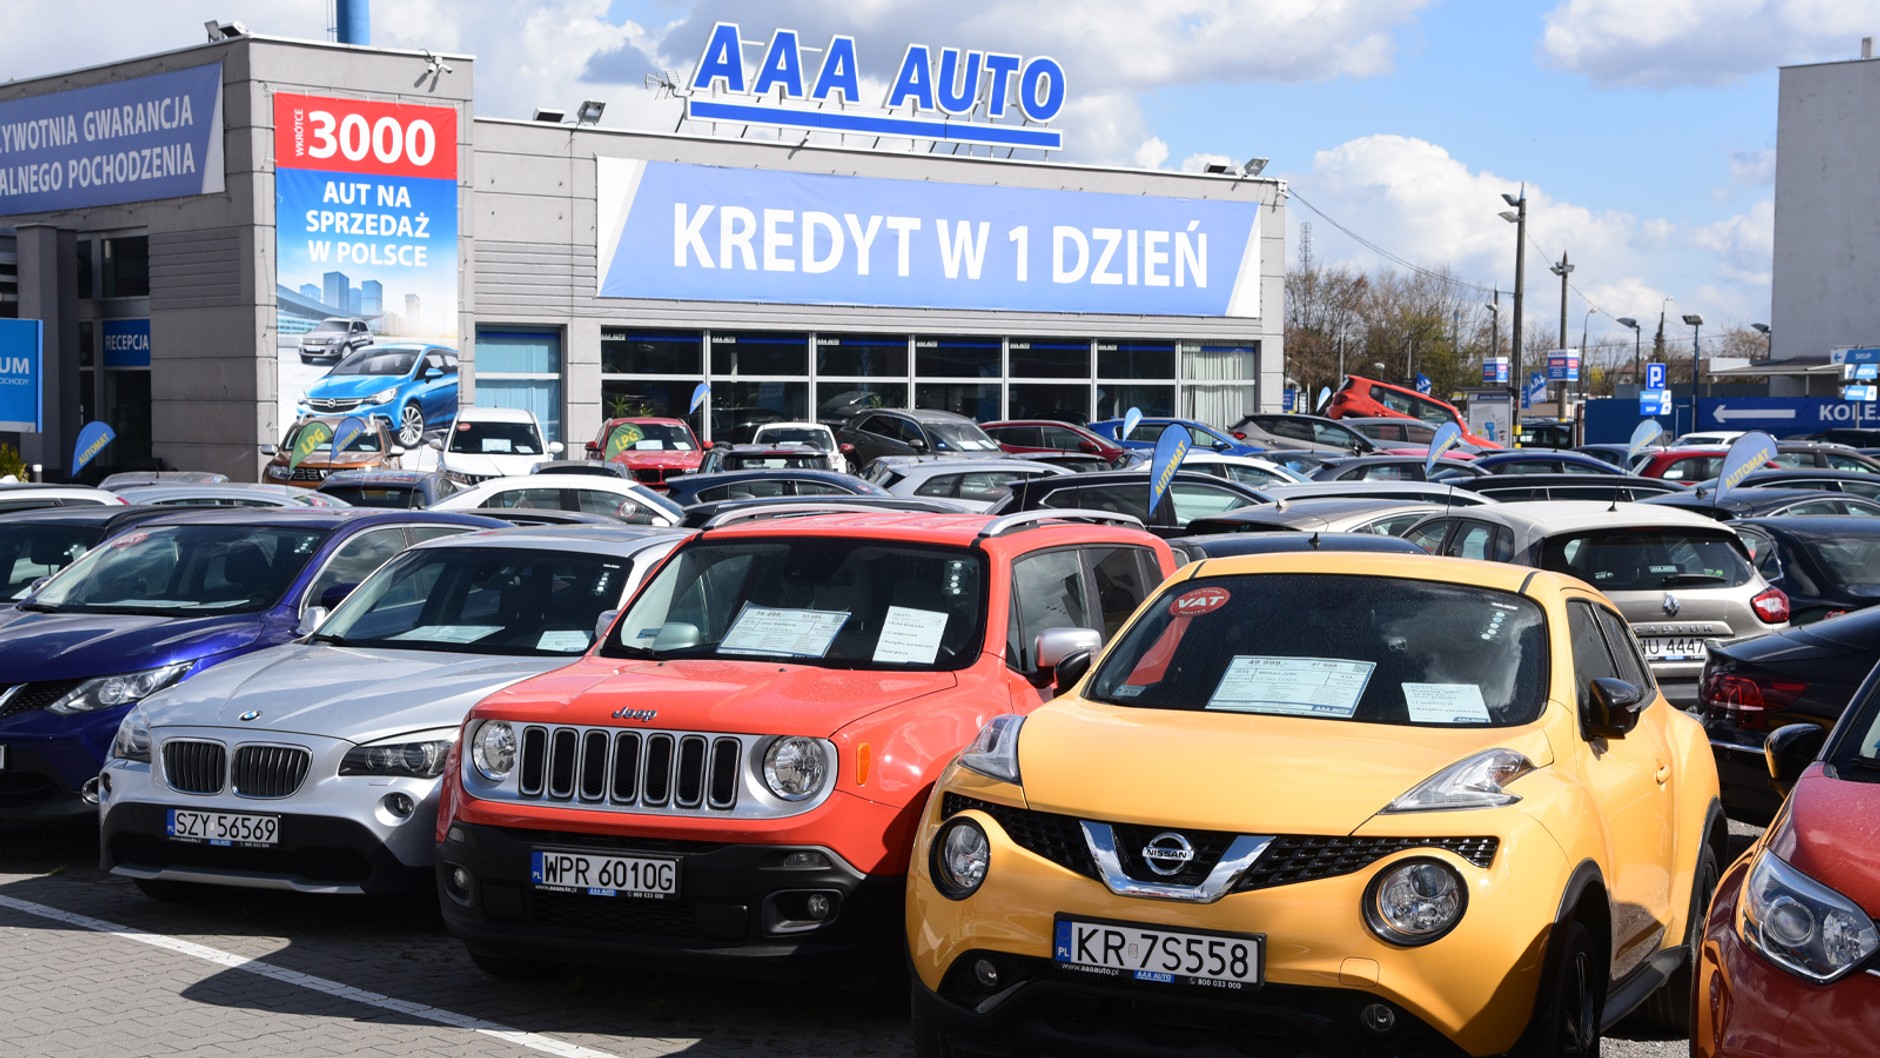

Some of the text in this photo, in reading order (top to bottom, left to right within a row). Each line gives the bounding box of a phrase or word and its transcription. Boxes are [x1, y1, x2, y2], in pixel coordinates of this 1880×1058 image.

[689, 21, 1068, 125] AAA AUTO
[0, 95, 193, 154] YWOTNIA GWARANCJA
[294, 108, 304, 157] WKRÓTCE
[308, 110, 436, 167] 3000
[68, 142, 196, 189] POCHODZENIA
[323, 181, 412, 208] AUT NA
[305, 210, 430, 238] SPRZEDAŻ
[307, 240, 428, 267] W POLSCE
[674, 202, 1208, 288] KREDYT W 1 DZIEŃ
[105, 334, 149, 350] RECEPCJA
[0, 356, 30, 374] UM
[1650, 366, 1662, 388] P
[1820, 404, 1880, 421] KOLE
[78, 432, 110, 466] AUTOMAT
[301, 428, 326, 455] LPG
[336, 426, 361, 452] AUTOMAT
[615, 429, 638, 451] LPG
[1432, 431, 1457, 462] AUTOMAT
[1155, 439, 1186, 497] AUTOMAT
[1725, 447, 1770, 489] AUTOMAT
[1179, 596, 1224, 608] VAT
[1633, 624, 1713, 634] CAPTUR
[611, 705, 657, 722] Jeep
[176, 812, 276, 841] SZY 56569
[1146, 849, 1187, 858] NISSAN
[532, 871, 542, 879] PL
[544, 855, 673, 891] WPR 6010G
[601, 888, 615, 896] AUTO
[1058, 946, 1069, 957] PL
[1077, 927, 1249, 979] KR 7S558
[1061, 962, 1119, 976] www.aaaauto.pl
[1137, 970, 1172, 982] AAA AUTO
[1197, 978, 1242, 989] 800 033 000
